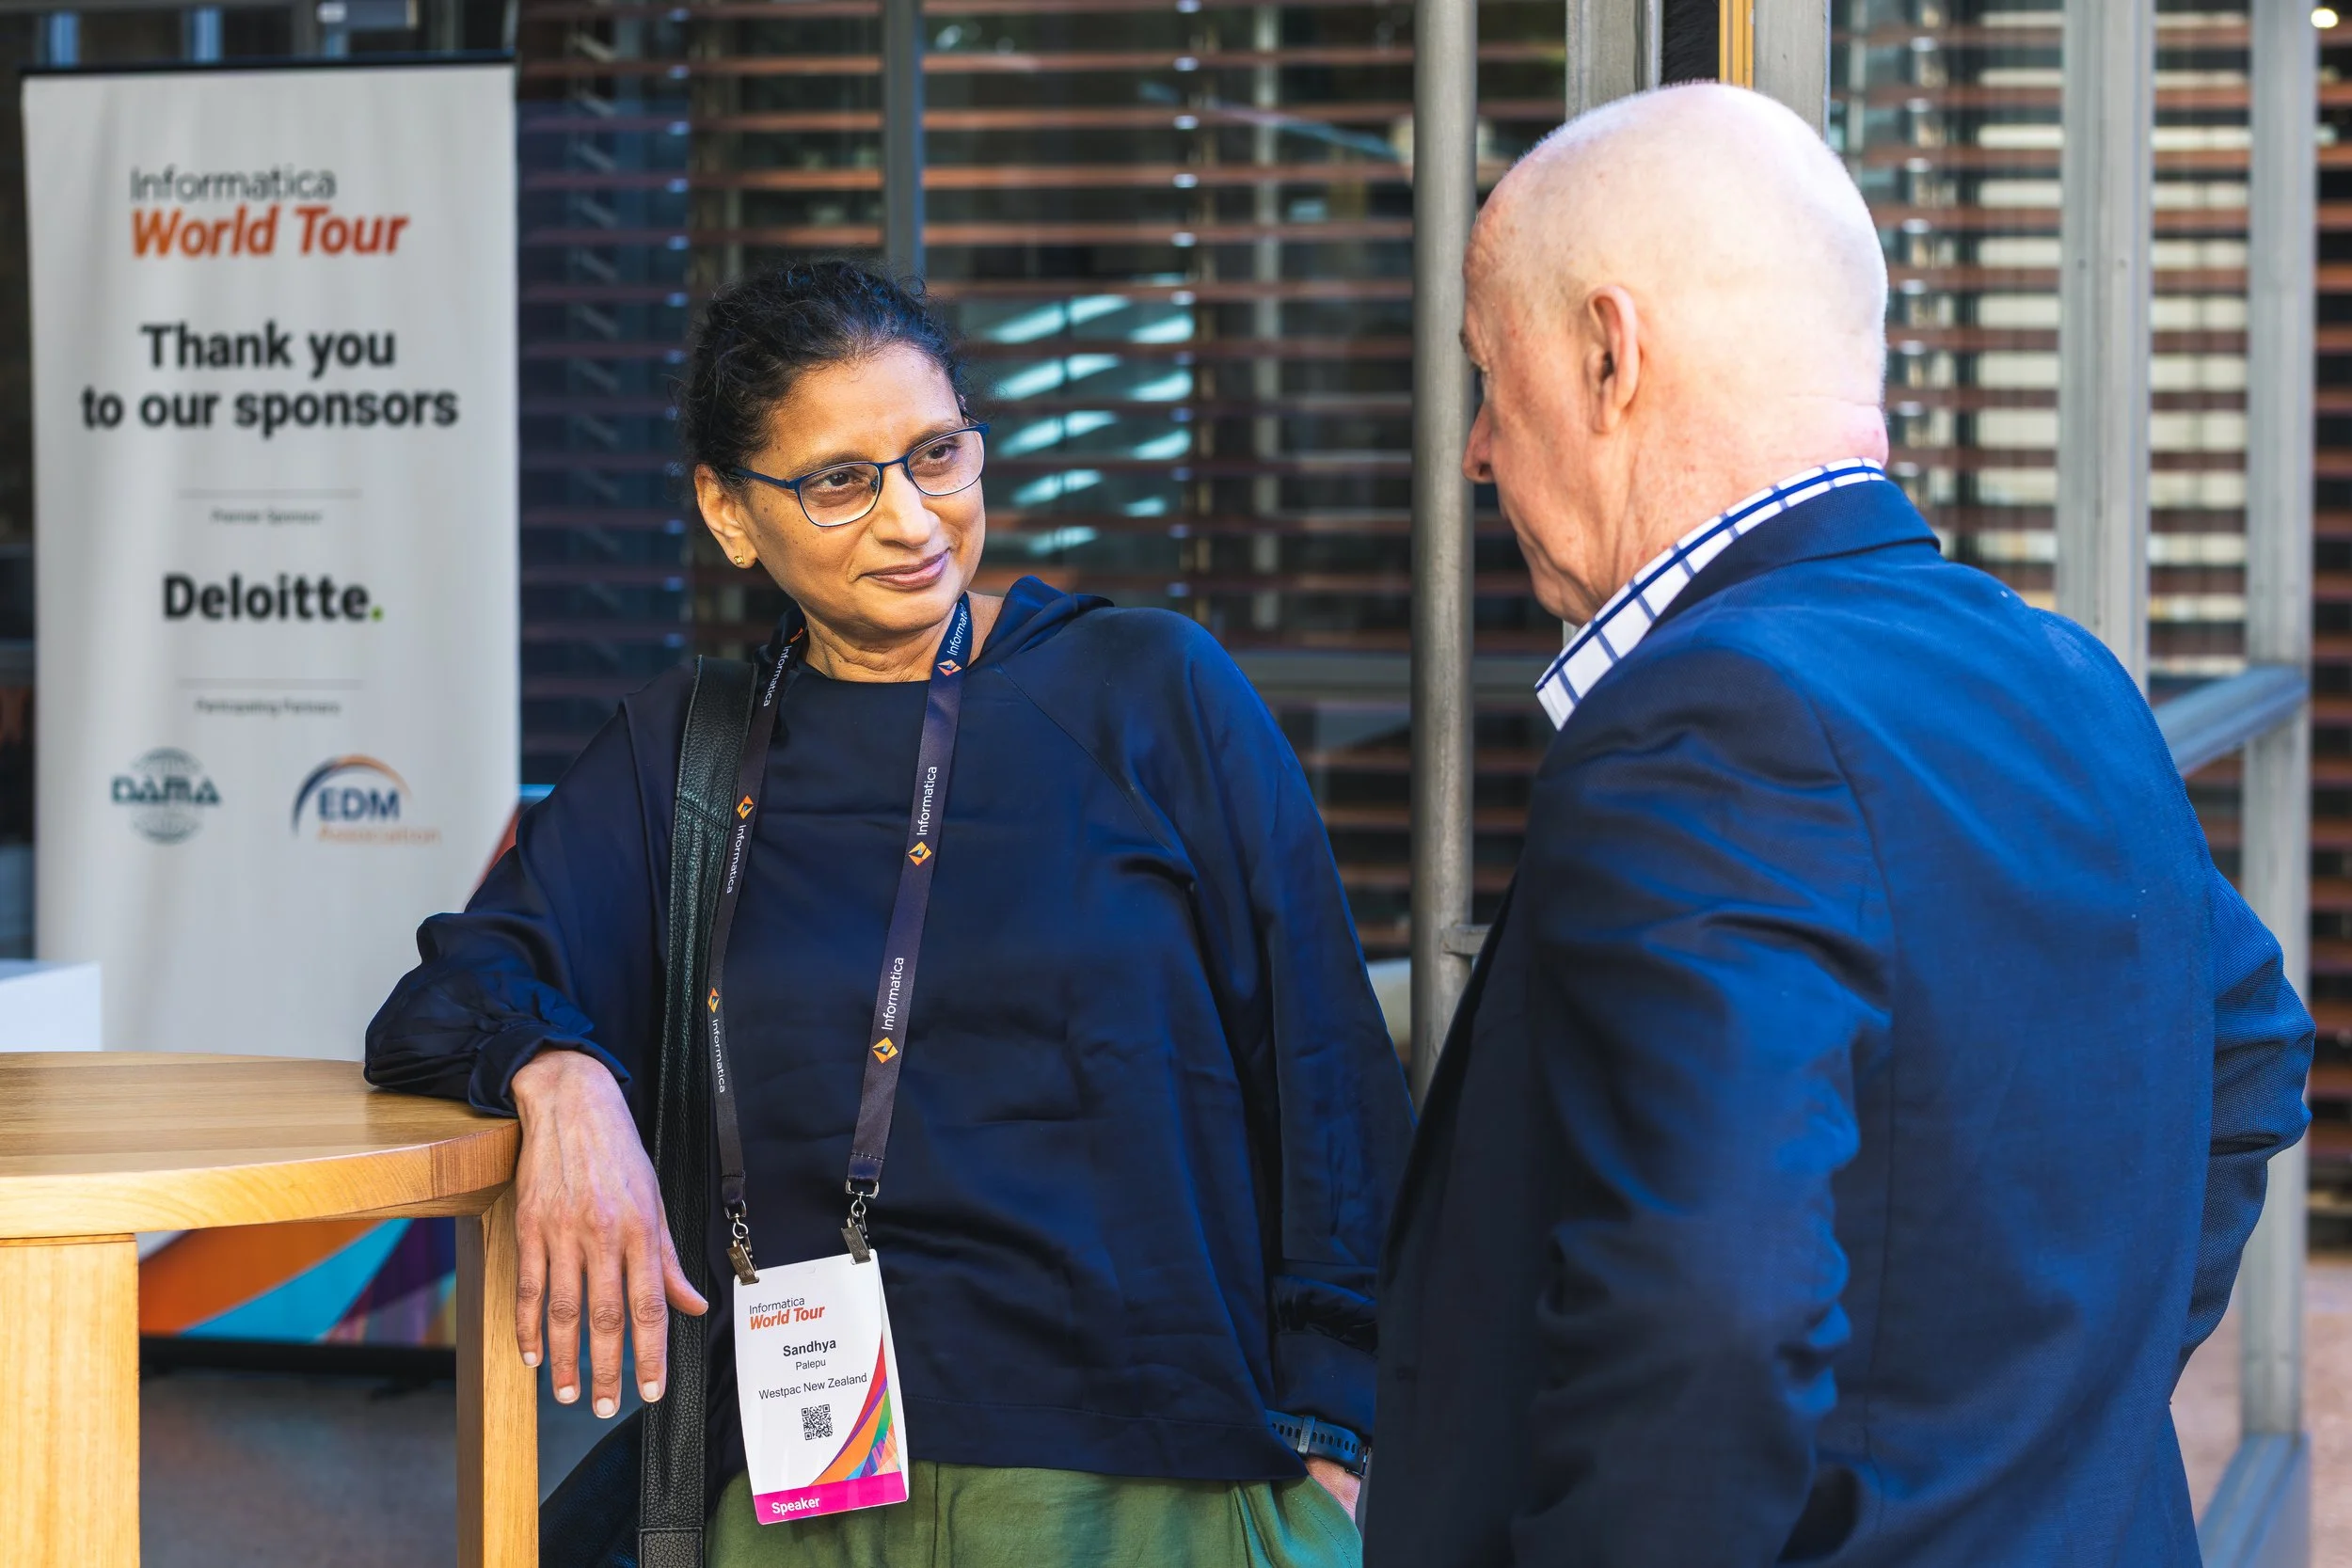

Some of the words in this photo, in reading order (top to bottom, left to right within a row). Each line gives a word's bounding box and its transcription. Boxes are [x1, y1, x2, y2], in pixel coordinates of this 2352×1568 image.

[130, 165, 337, 202] Informatica
[132, 204, 280, 259] World
[294, 204, 408, 256] Tour
[140, 321, 293, 370] Thank
[307, 330, 397, 378] you
[82, 387, 124, 429] to
[140, 390, 220, 428] our
[234, 390, 459, 439] sponsors
[163, 573, 383, 622] Deloitte.
[763, 645, 792, 706] Informatica
[111, 775, 221, 805] DAMA
[317, 786, 400, 821] EDM
[914, 766, 938, 835] Informatica
[726, 824, 747, 894] Informatica
[881, 957, 905, 1031] Informatica
[712, 1019, 725, 1093] Informatica
[749, 1297, 805, 1315] Informatica
[750, 1308, 790, 1330] World
[793, 1306, 825, 1323] Tour
[783, 1339, 836, 1357] Sandhya
[795, 1359, 826, 1370] Palepu
[758, 1385, 802, 1400] Westpac
[803, 1381, 826, 1393] New
[828, 1372, 867, 1388] Zealand
[771, 1497, 820, 1516] Speaker
